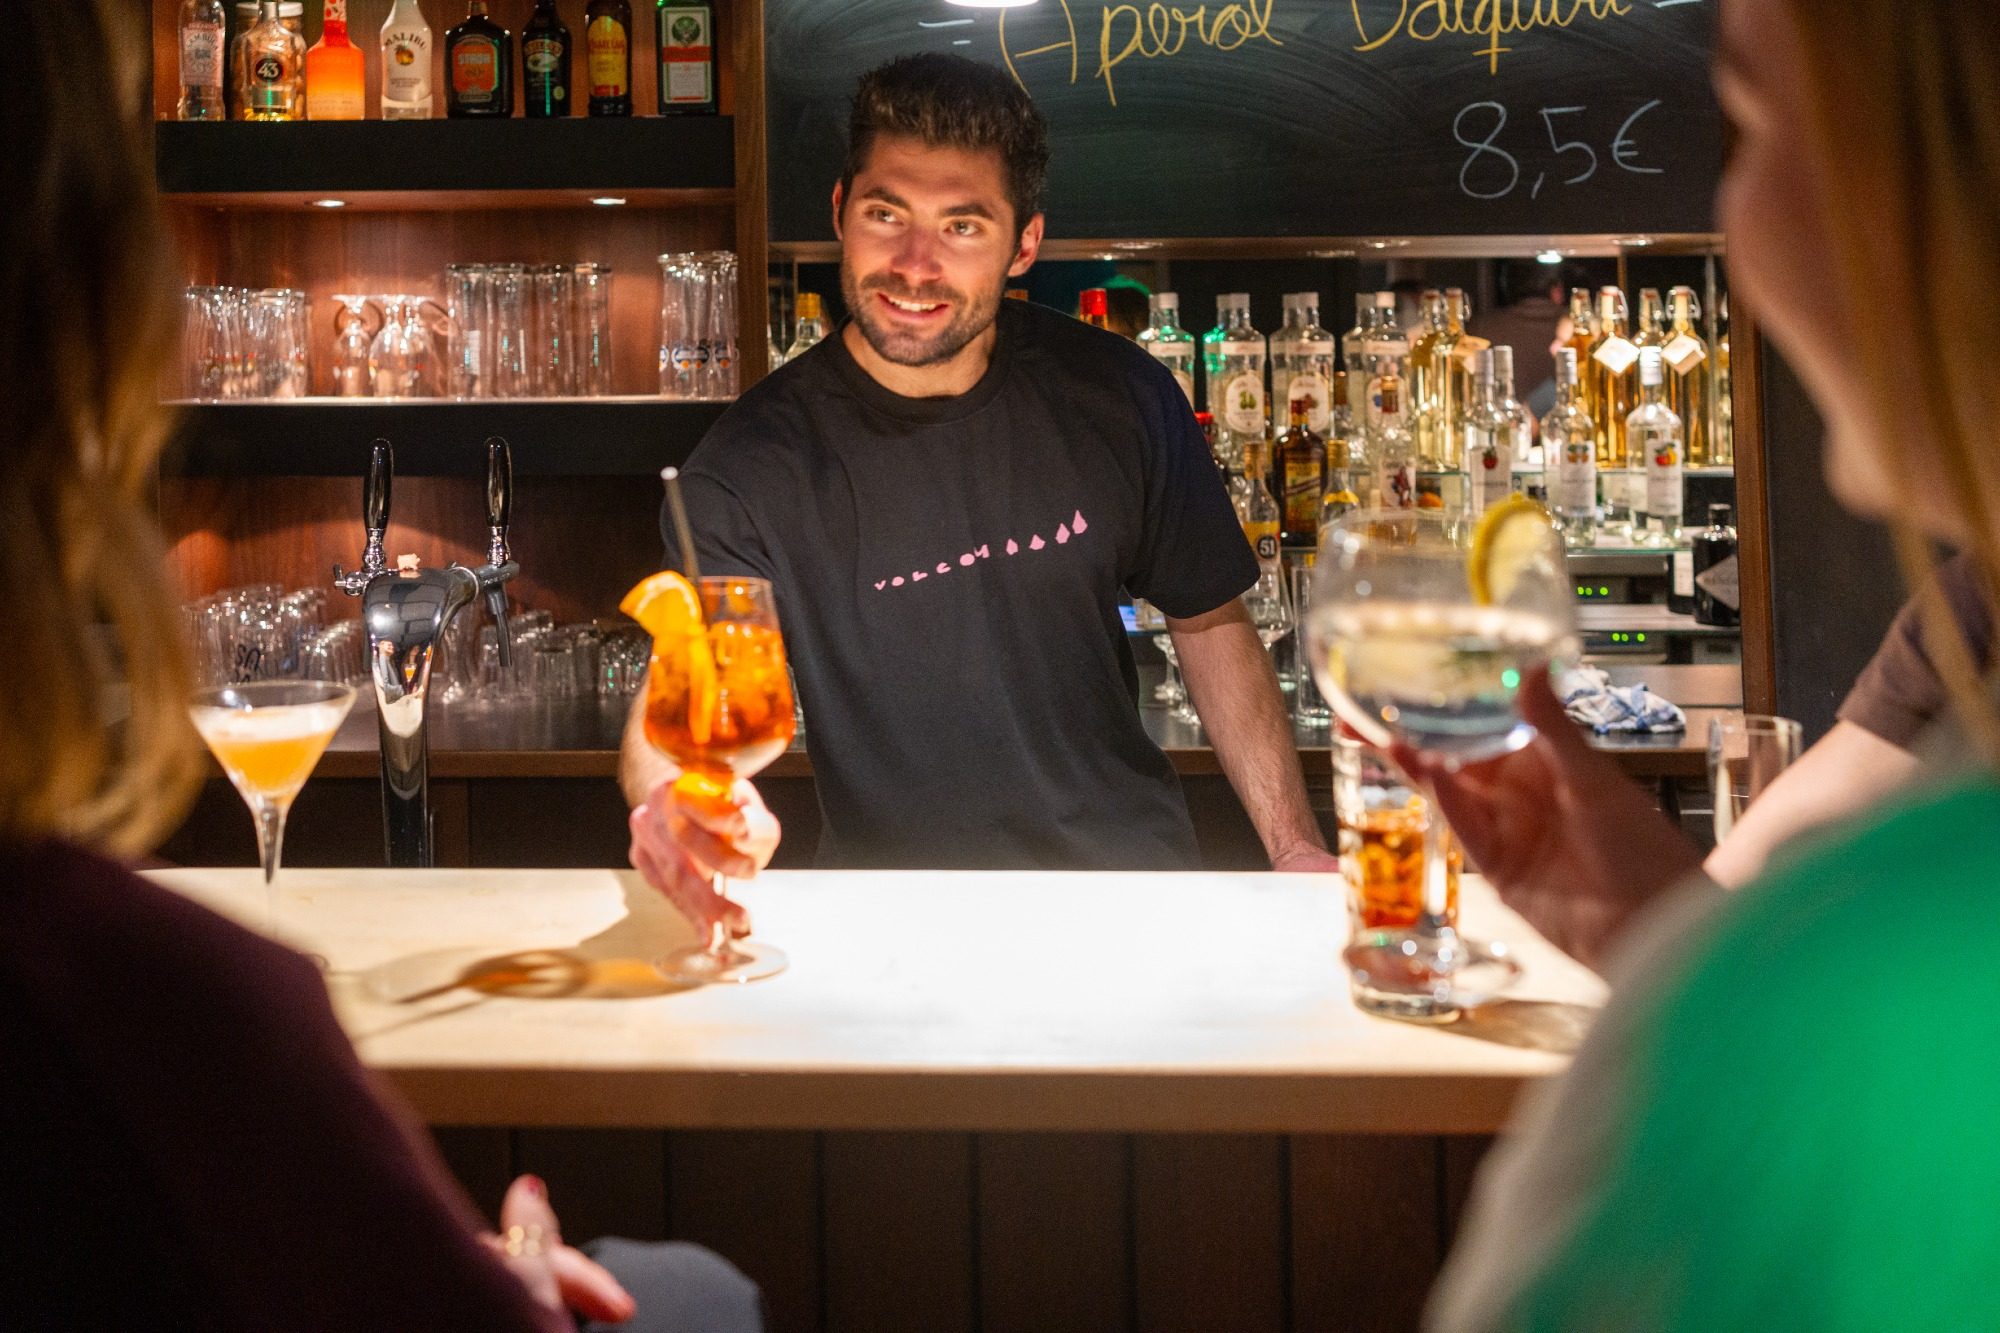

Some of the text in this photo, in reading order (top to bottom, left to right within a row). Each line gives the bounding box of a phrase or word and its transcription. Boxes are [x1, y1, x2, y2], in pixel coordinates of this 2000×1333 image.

[384, 31, 428, 51] MALIBU
[257, 61, 280, 79] 43
[1258, 538, 1276, 556] 51
